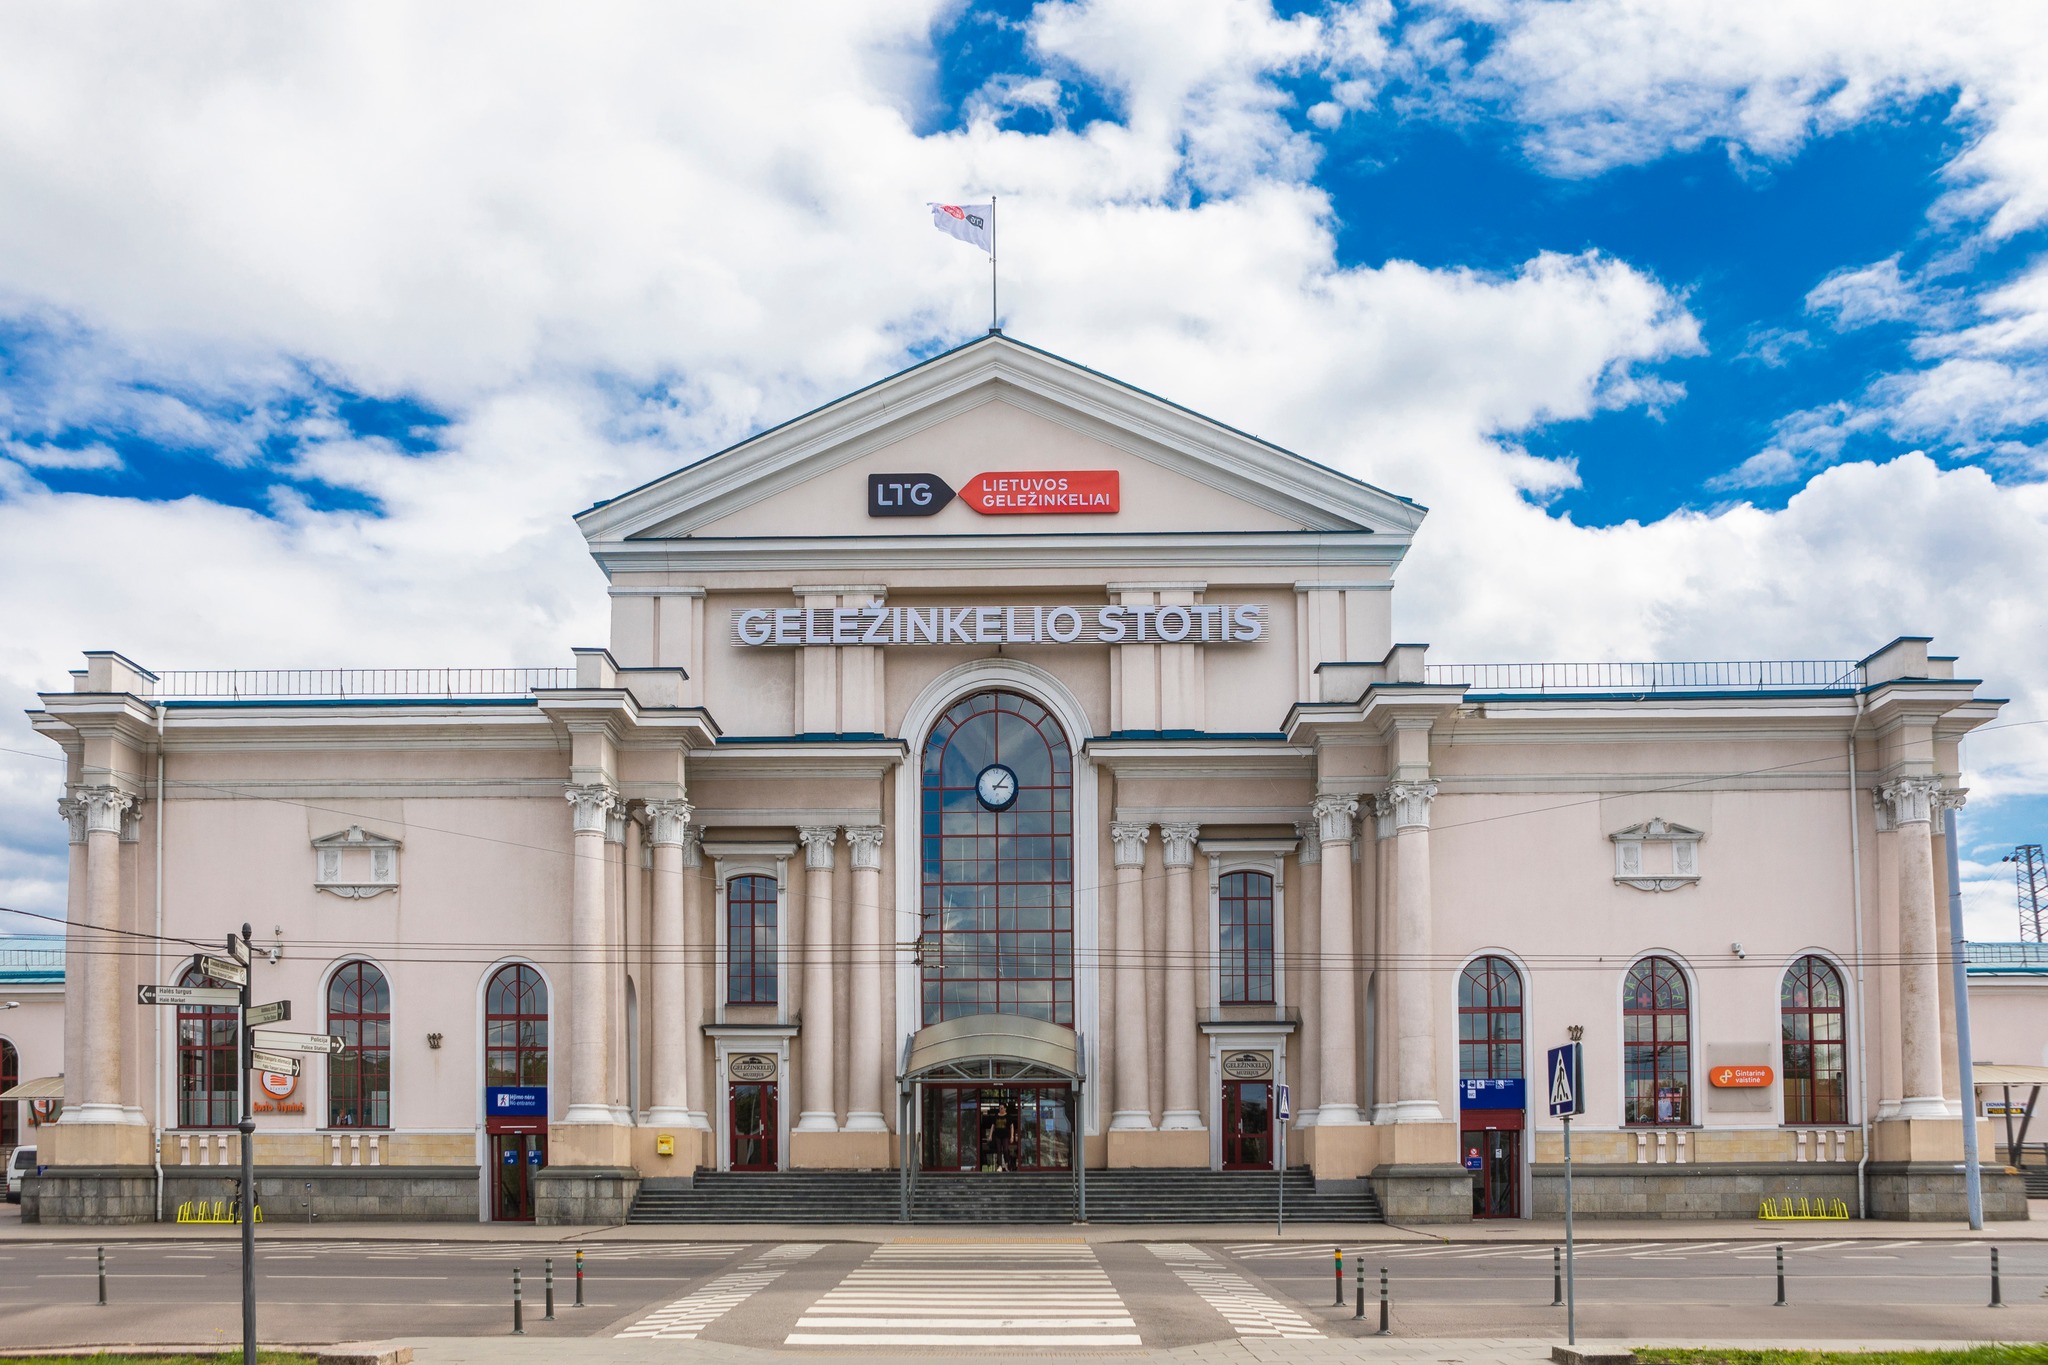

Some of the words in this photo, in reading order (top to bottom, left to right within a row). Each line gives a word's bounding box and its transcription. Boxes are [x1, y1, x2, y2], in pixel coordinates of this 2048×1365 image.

[983, 478, 1068, 491] LIETUVOS
[877, 483, 933, 506] LTG
[983, 491, 1110, 507] GELEŽINKELIAI
[737, 599, 1082, 645] GELEŽINKELIO
[1098, 605, 1261, 642] STOTIS
